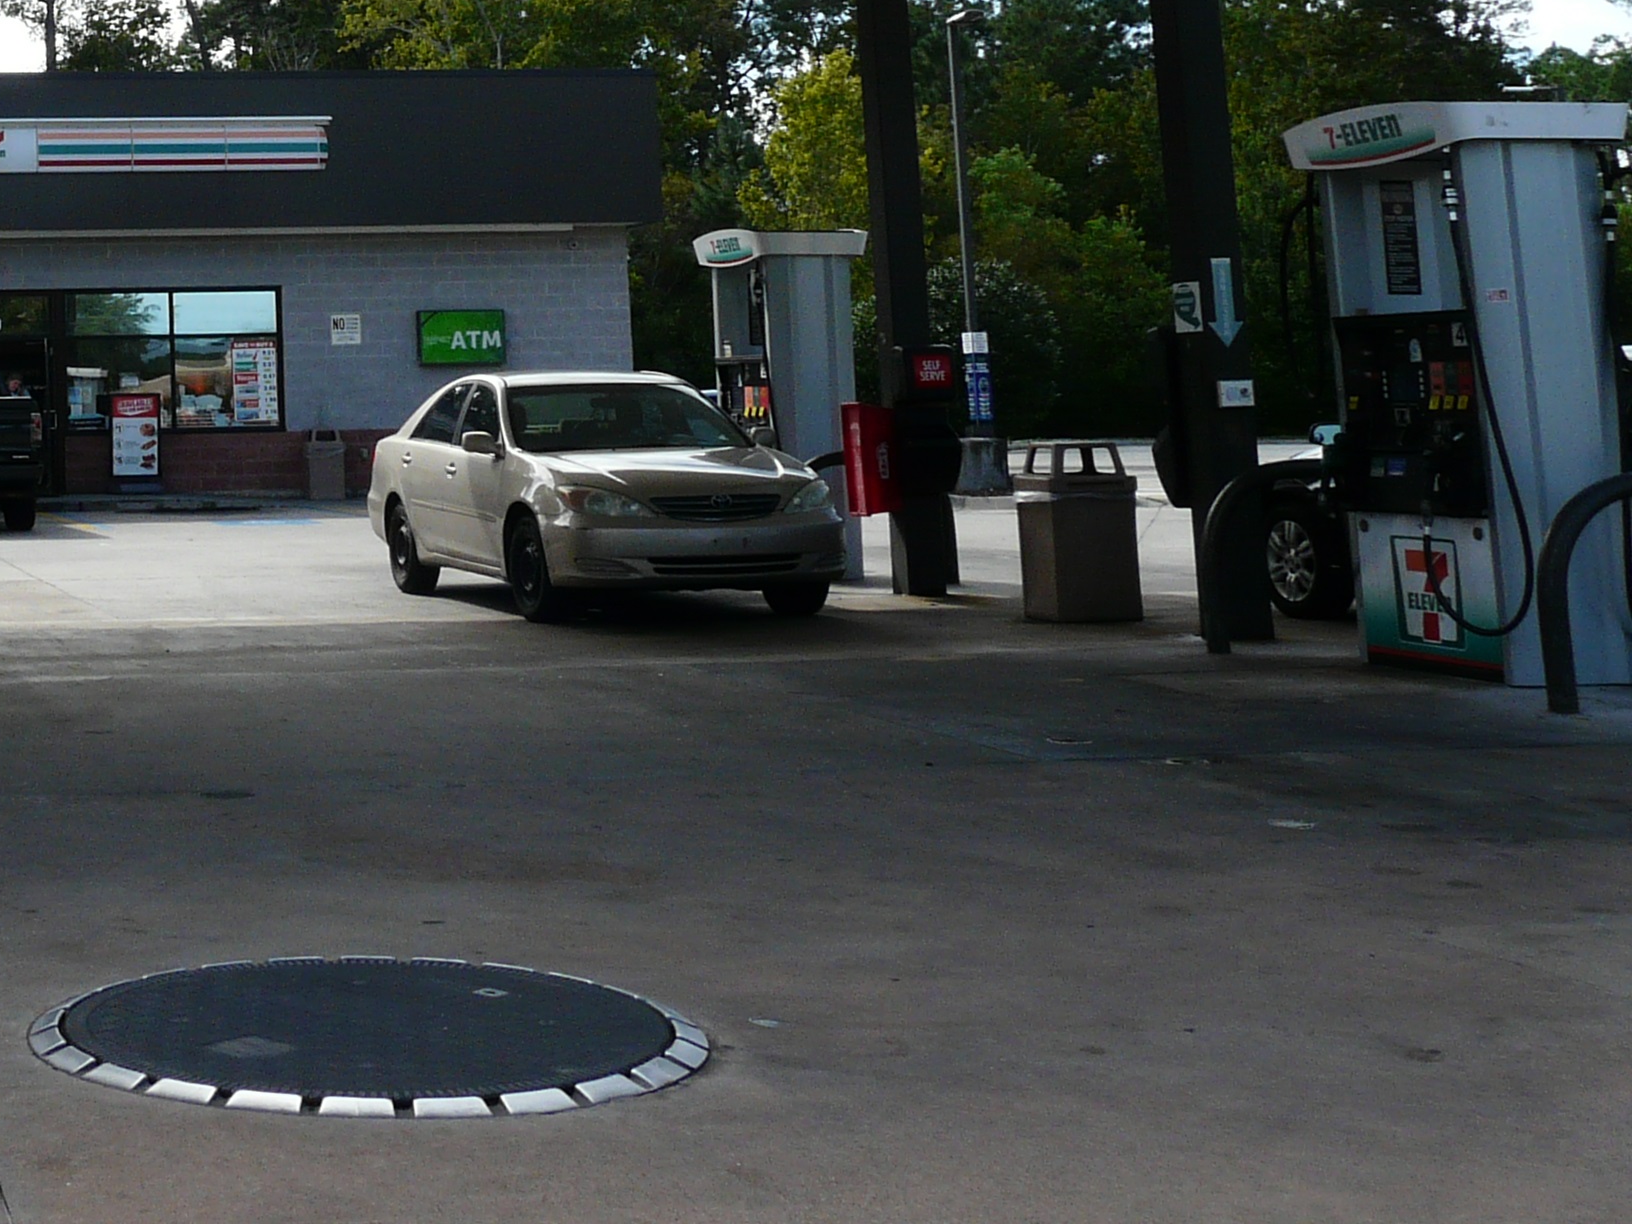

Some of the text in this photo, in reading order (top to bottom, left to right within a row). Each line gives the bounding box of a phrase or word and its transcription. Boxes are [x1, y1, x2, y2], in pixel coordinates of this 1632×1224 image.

[332, 317, 345, 330] NO
[450, 330, 502, 350] ATM
[922, 360, 941, 370] SELF
[920, 371, 945, 381] SERVE
